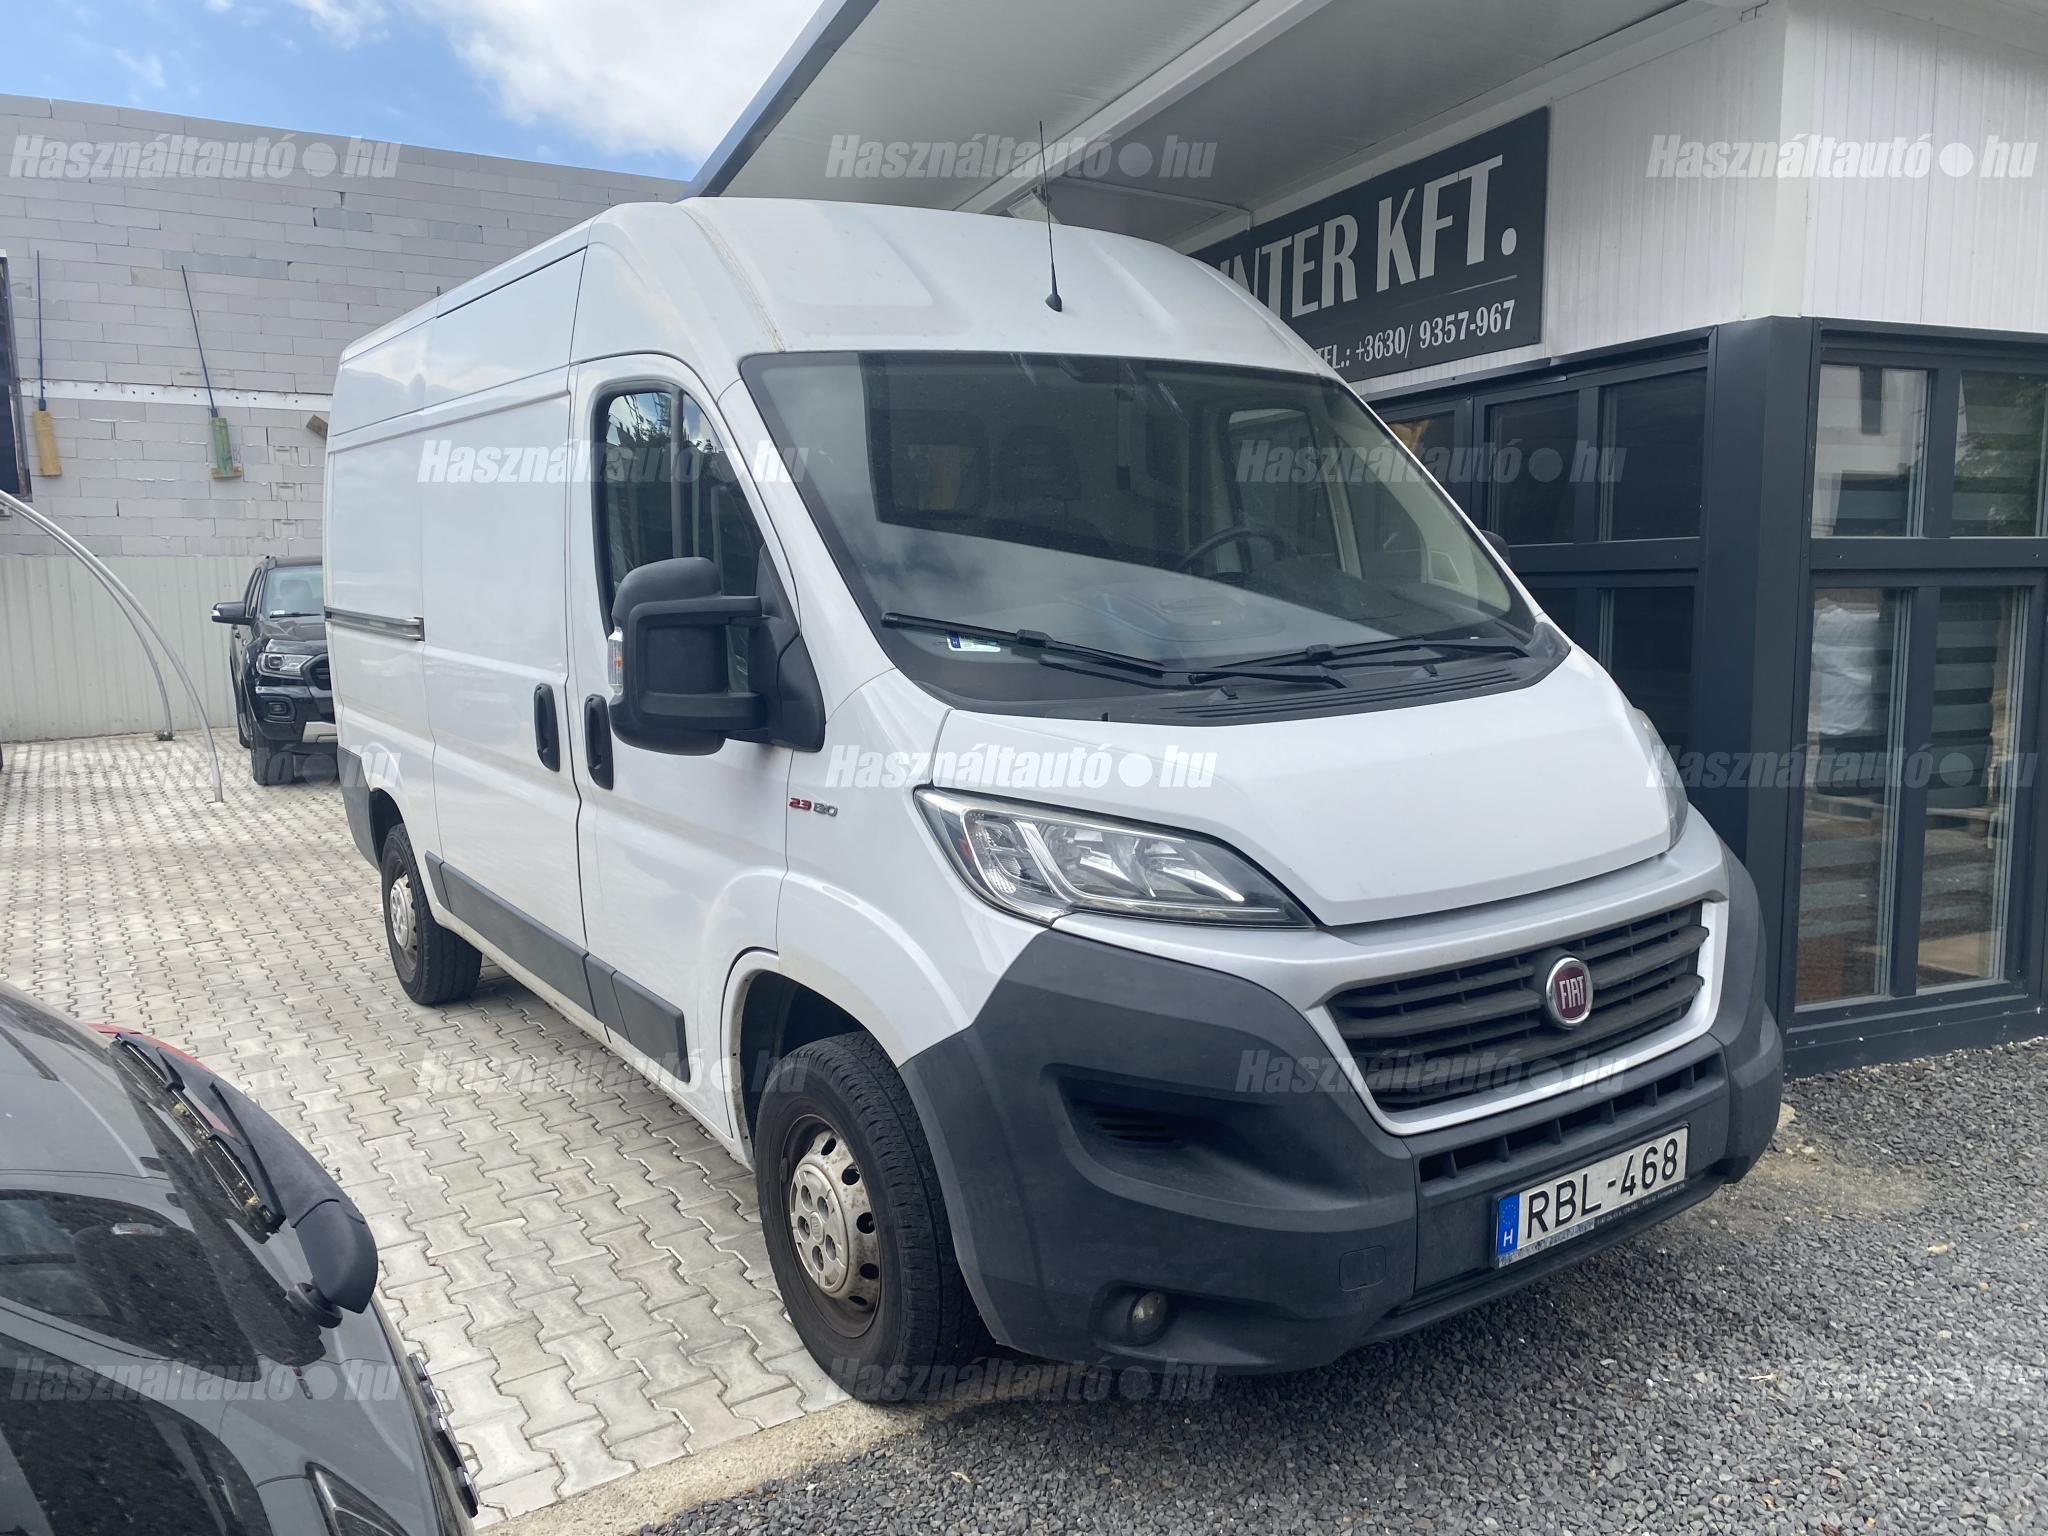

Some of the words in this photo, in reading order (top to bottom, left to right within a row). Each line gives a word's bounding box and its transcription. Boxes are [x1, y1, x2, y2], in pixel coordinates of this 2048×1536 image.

[1376, 154, 1518, 293] KFT.
[1355, 323, 1414, 359] +3630/
[1418, 299, 1515, 349] 9357-967
[1559, 975, 1584, 1010] FIAT
[1503, 1228, 1513, 1248] H
[1526, 1138, 1678, 1240] RBL-468
